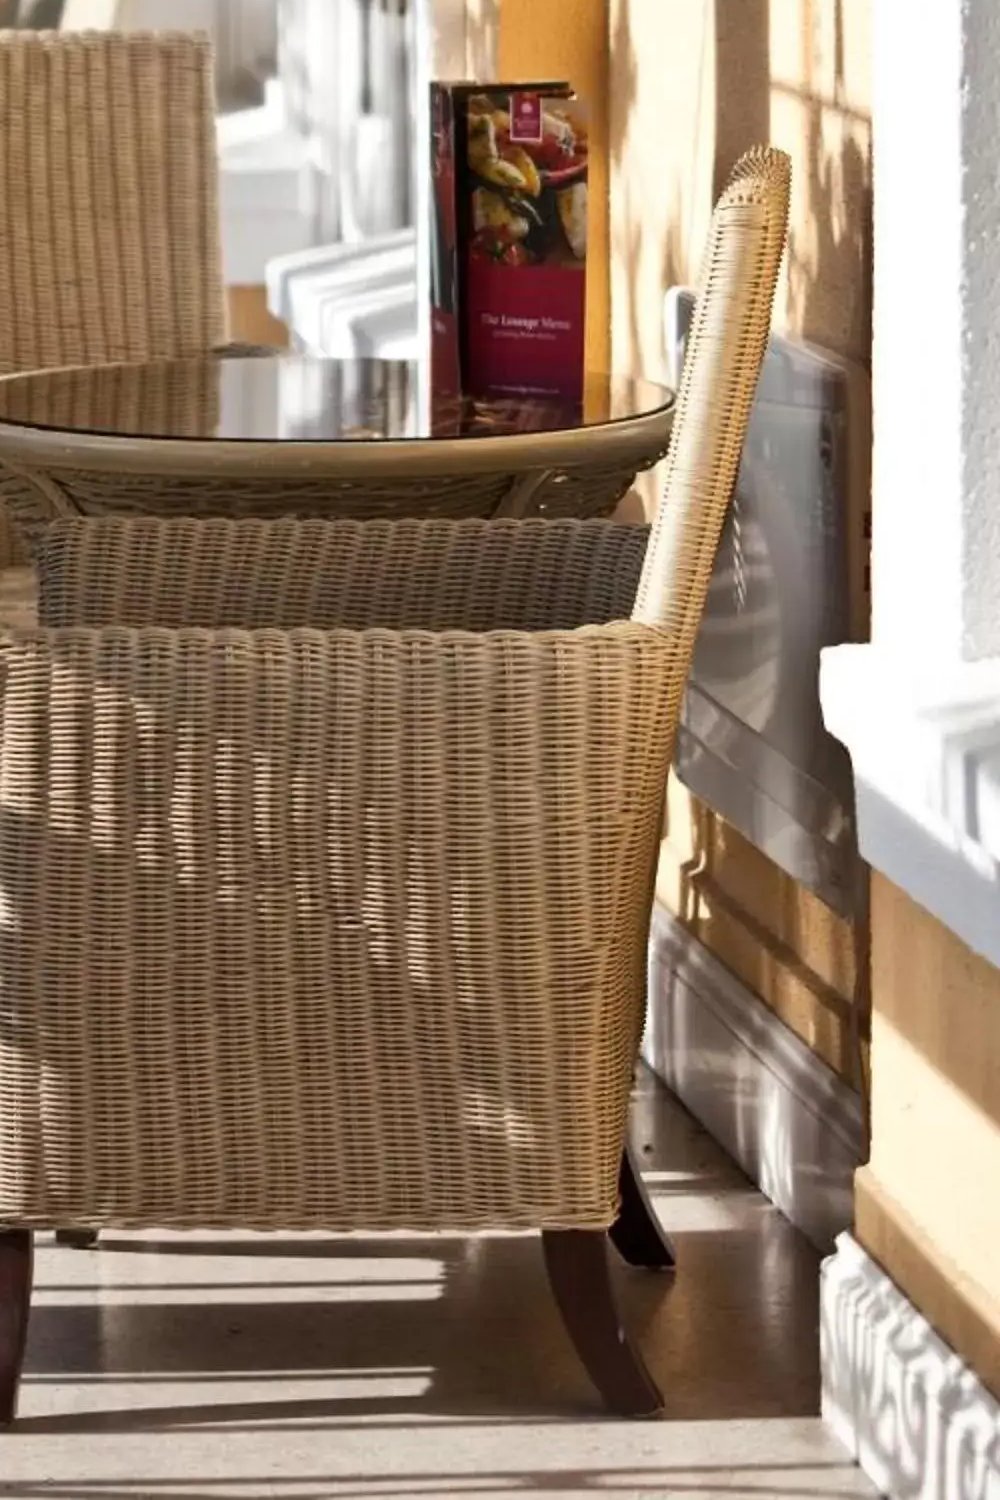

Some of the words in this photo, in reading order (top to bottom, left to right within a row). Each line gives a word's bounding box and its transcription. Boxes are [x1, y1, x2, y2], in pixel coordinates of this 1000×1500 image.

[481, 313, 499, 325] The
[501, 314, 539, 330] Lounge
[540, 316, 571, 331] Menu
